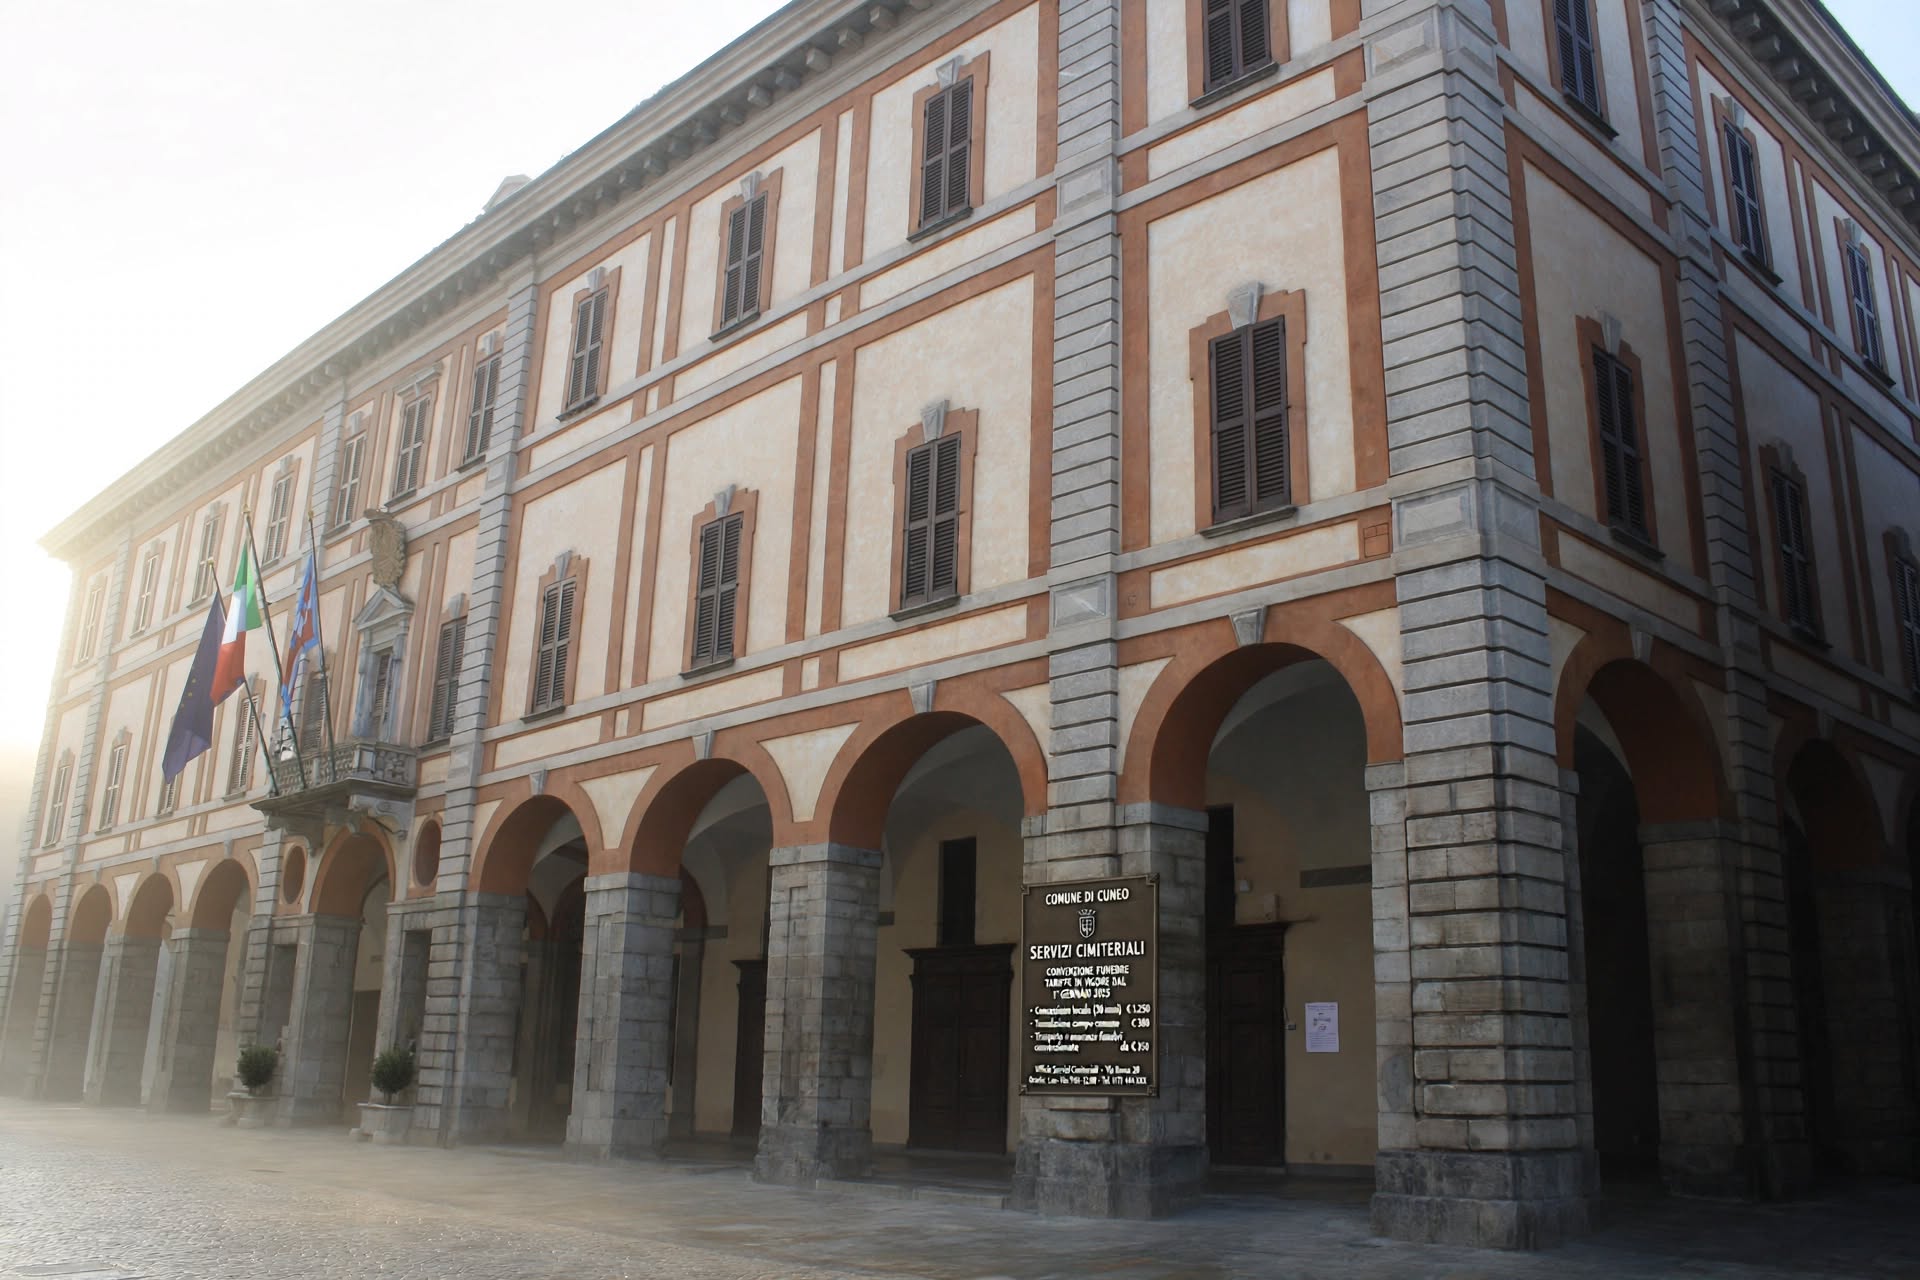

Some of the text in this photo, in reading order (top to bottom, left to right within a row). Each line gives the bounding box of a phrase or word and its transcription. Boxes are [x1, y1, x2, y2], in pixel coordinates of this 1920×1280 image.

[1045, 888, 1130, 905] COMUNE DI CUNEO
[1030, 940, 1145, 960] SERVIZI CIMITERIALI
